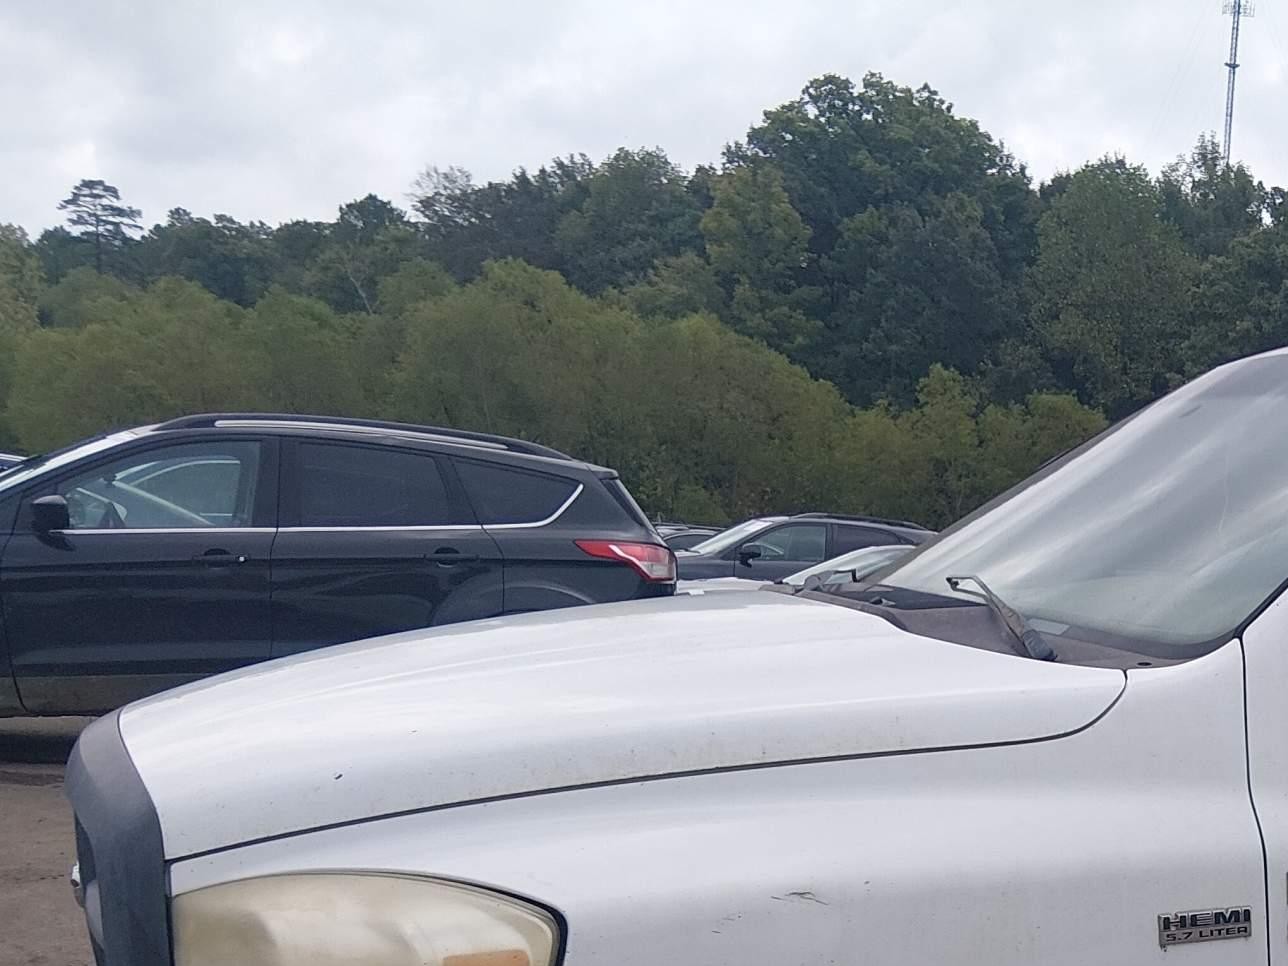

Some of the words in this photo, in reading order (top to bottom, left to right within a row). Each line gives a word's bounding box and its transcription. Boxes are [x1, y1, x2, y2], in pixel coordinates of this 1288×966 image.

[1159, 906, 1251, 930] HEMI
[1166, 931, 1193, 942] 5.7
[1199, 926, 1248, 938] LITER
